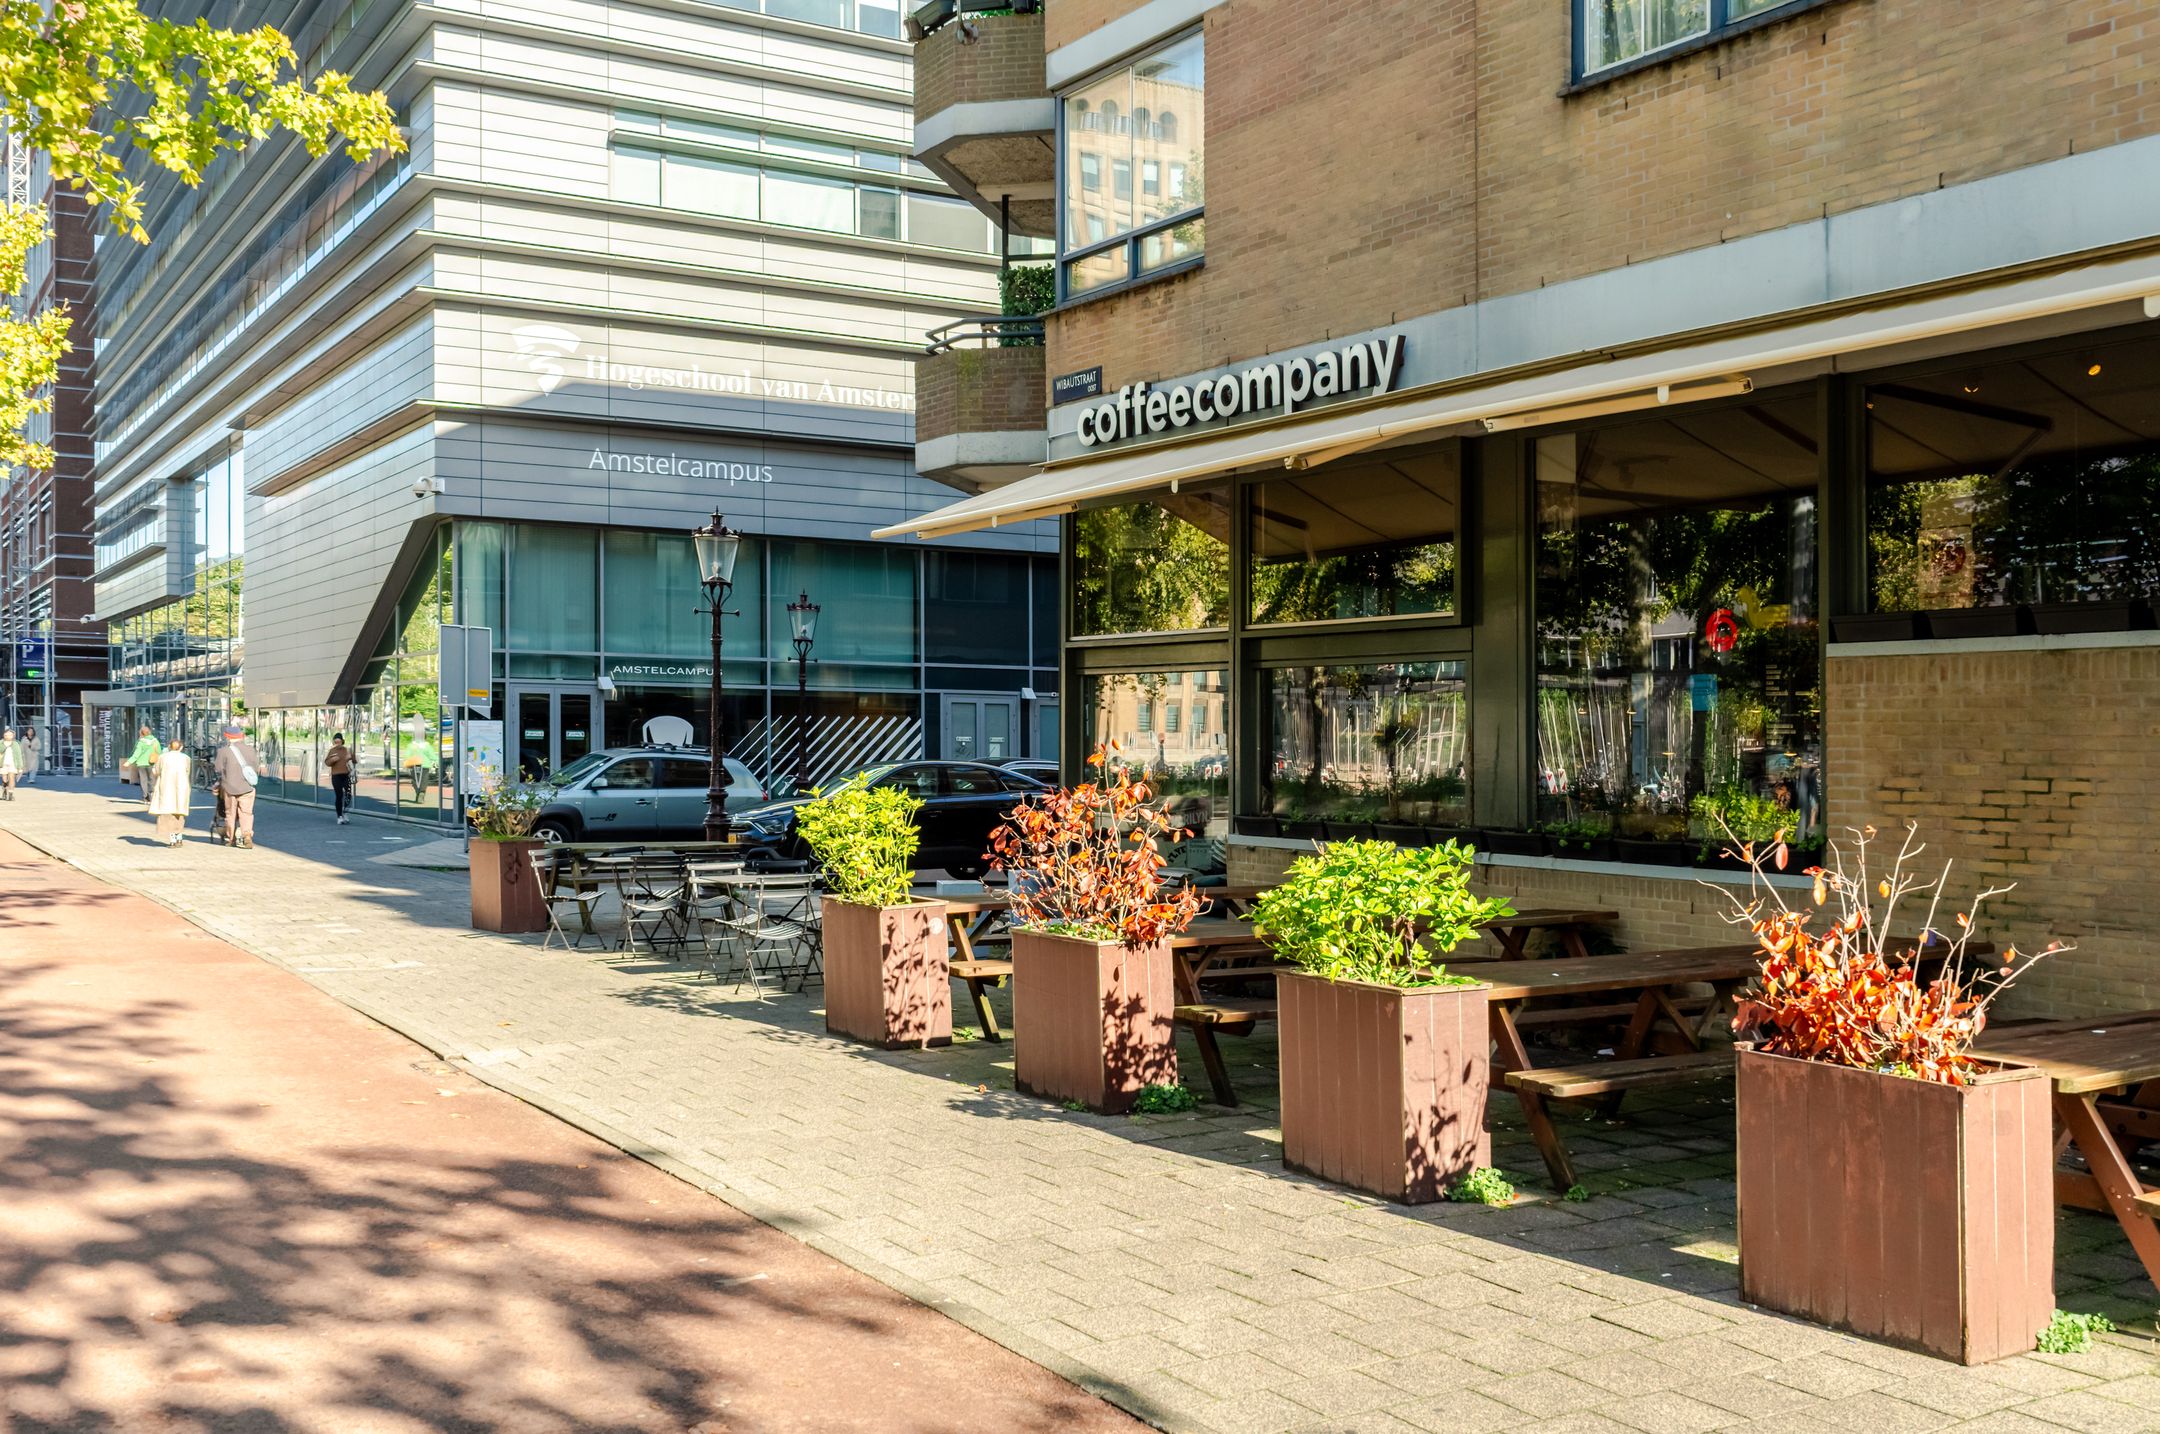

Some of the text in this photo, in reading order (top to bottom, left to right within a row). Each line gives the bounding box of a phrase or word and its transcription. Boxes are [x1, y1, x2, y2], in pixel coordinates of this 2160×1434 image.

[585, 354, 915, 410] Hogeschool van Amster
[1056, 370, 1097, 390] WIBAUTSTRAAT
[1077, 335, 1405, 446] coffeecompany
[588, 448, 773, 487] Amstelcampus
